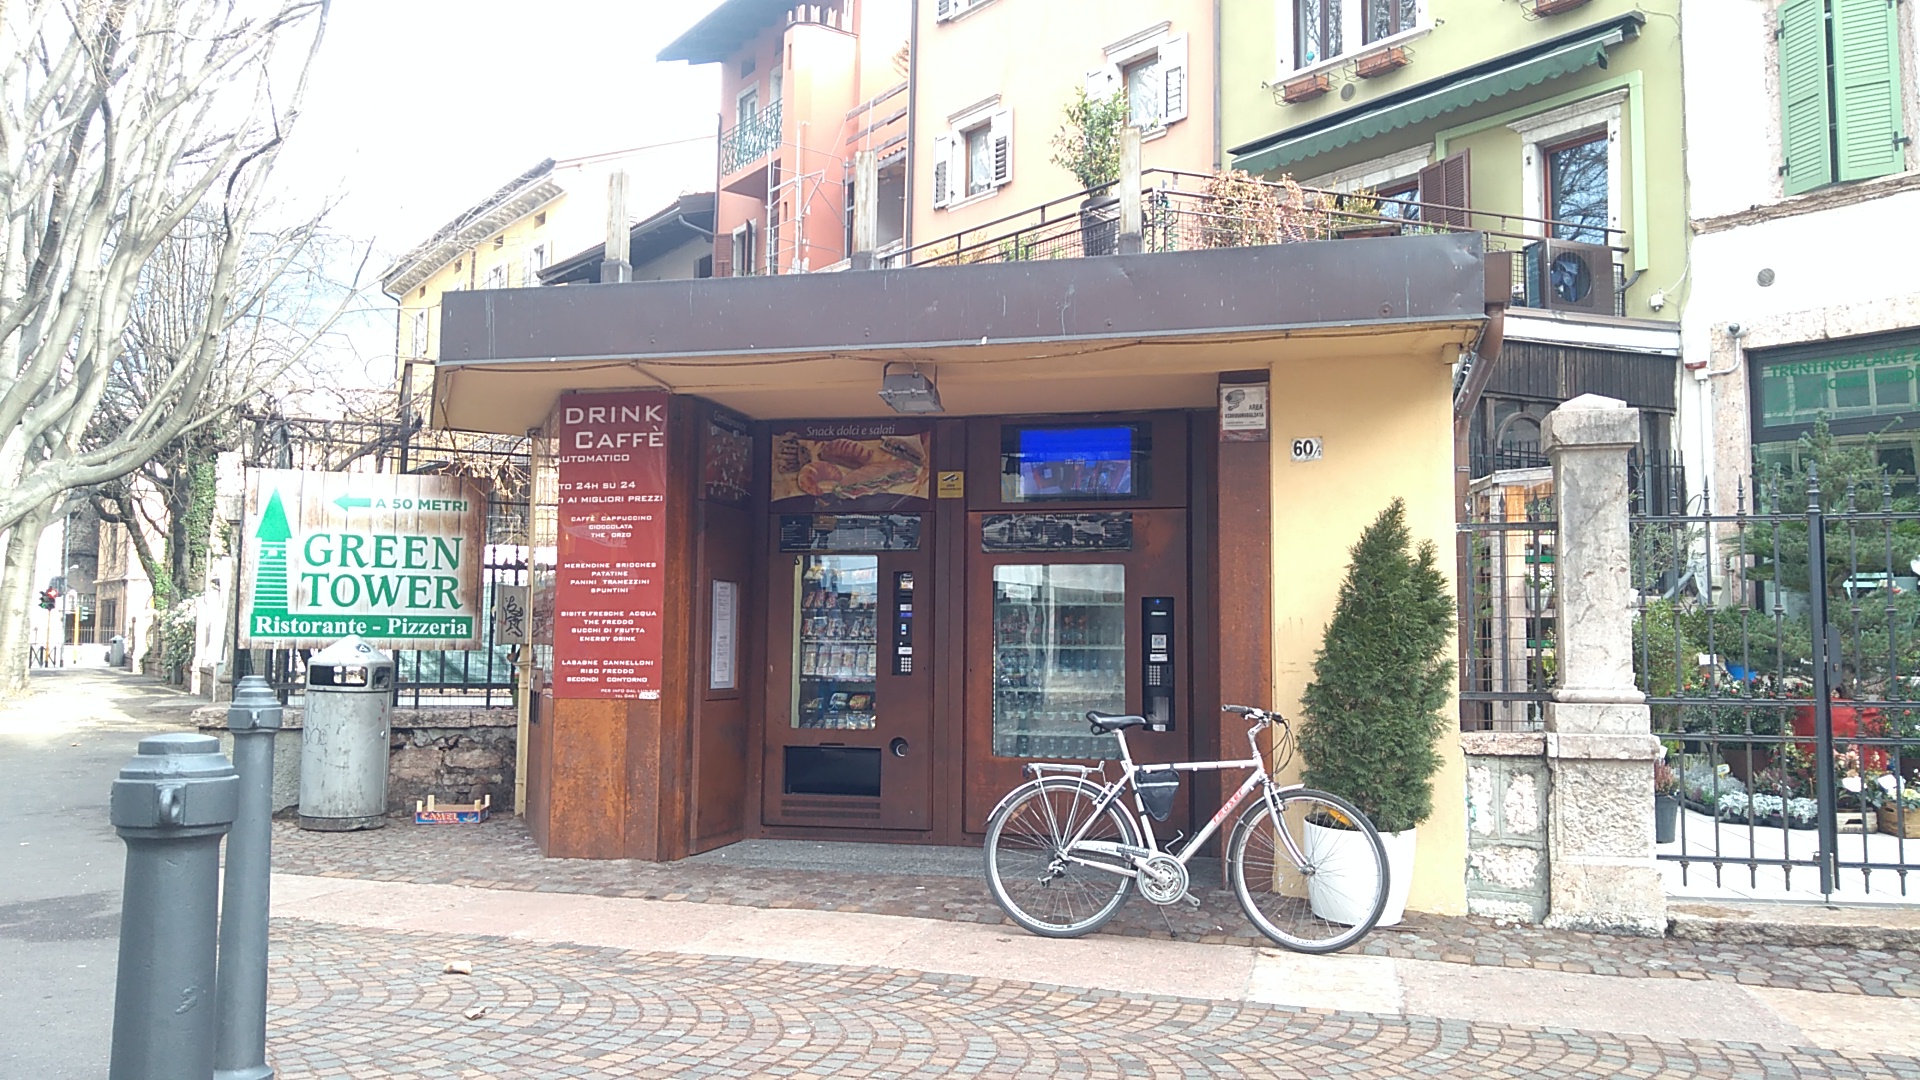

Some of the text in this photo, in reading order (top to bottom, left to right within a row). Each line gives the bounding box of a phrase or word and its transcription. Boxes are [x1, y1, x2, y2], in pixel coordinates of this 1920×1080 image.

[1771, 348, 1906, 377] TRENTINOPLANT
[565, 404, 663, 425] DRINK
[575, 425, 664, 449] CAFFÈ
[806, 424, 896, 437] Snack dolci e salati
[576, 482, 599, 490] 24H
[620, 481, 636, 489] 24
[375, 498, 468, 511] A 50 METRI
[567, 496, 577, 504] AI
[581, 495, 624, 503] MIGLIORI
[303, 532, 464, 570] GREEN
[300, 572, 463, 610] TOWER
[255, 615, 367, 635] Ristorante
[388, 617, 468, 636] Pizzeria
[421, 812, 460, 820] CAMEL
